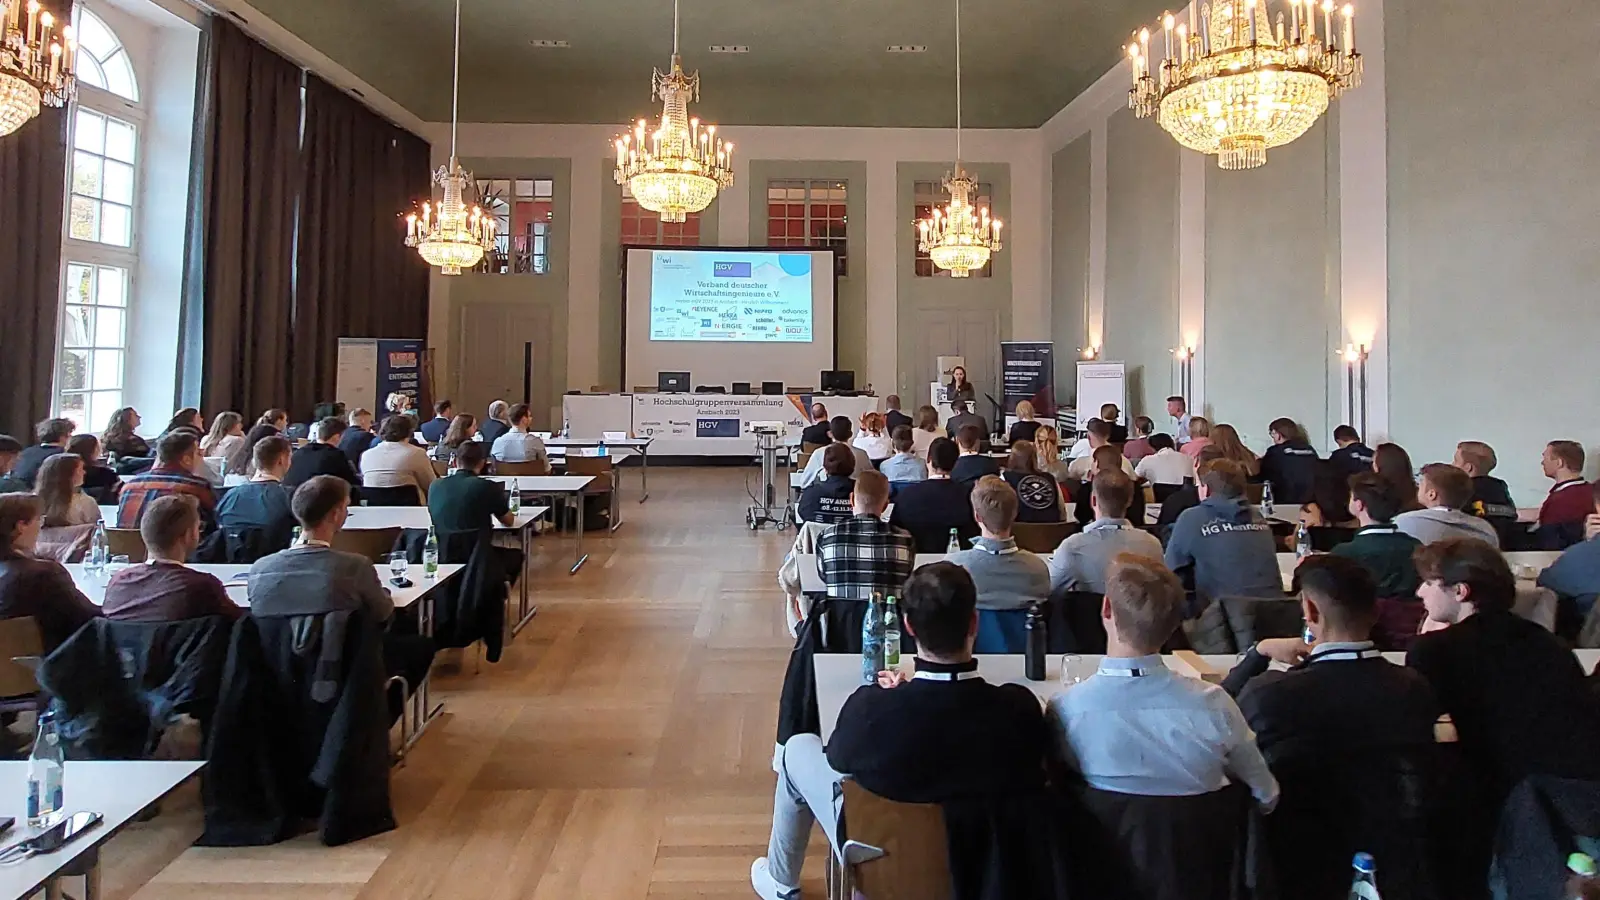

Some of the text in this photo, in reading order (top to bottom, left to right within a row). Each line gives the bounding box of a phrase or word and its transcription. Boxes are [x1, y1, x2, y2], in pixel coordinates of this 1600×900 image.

[683, 289, 766, 298] Wirtschaftsingenieure
[653, 398, 784, 407] Hochschulgruppenversammlung
[1201, 524, 1220, 536] HG
